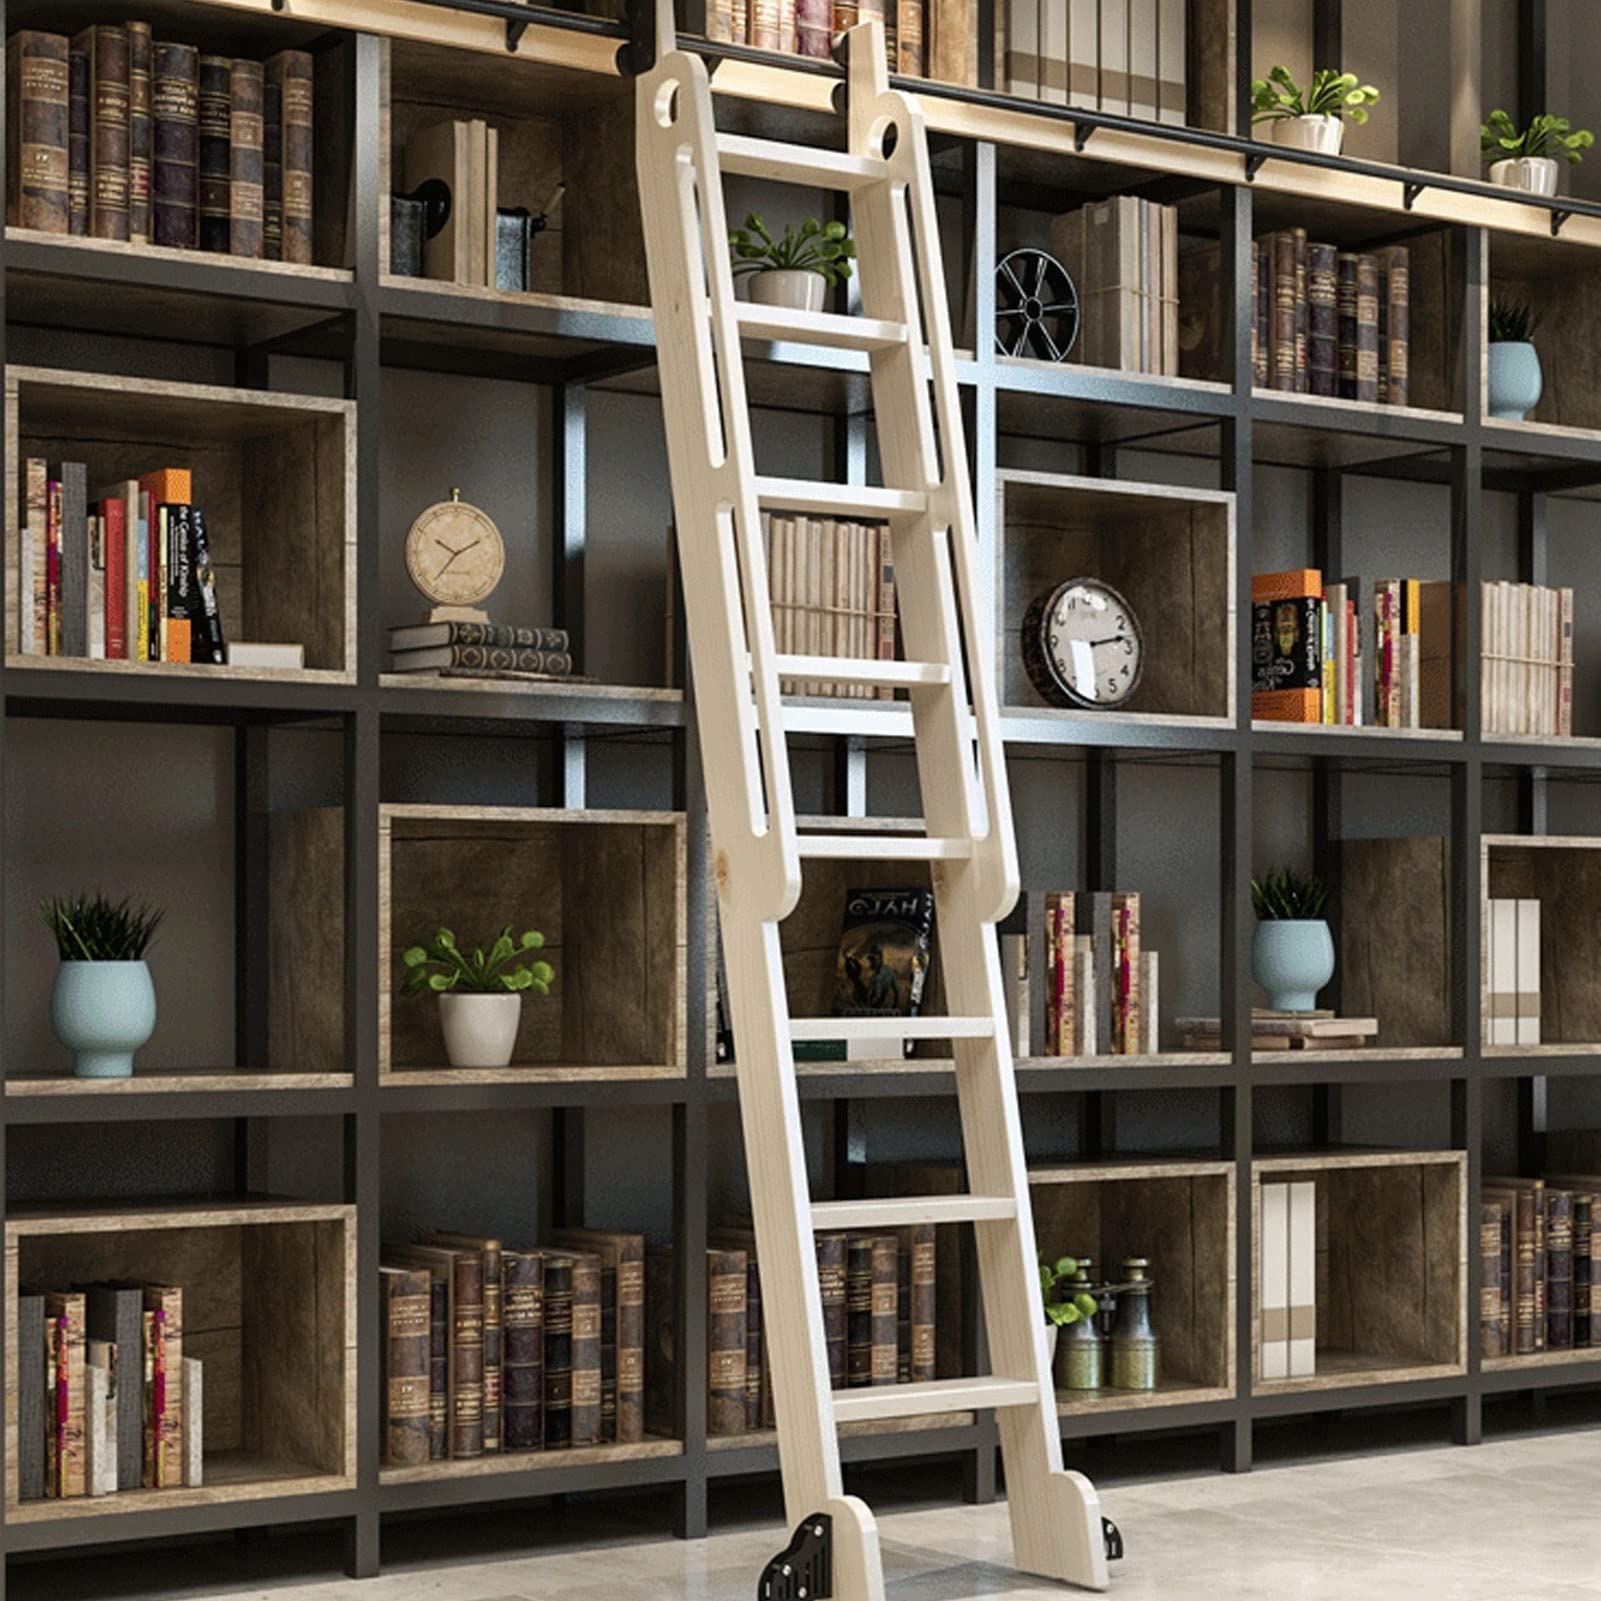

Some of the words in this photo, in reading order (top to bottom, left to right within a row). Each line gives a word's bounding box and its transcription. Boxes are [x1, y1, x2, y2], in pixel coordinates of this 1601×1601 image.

[1116, 615, 1125, 630] 2
[1124, 640, 1133, 655] 3
[1120, 664, 1129, 676] 4
[1108, 678, 1117, 693] 5
